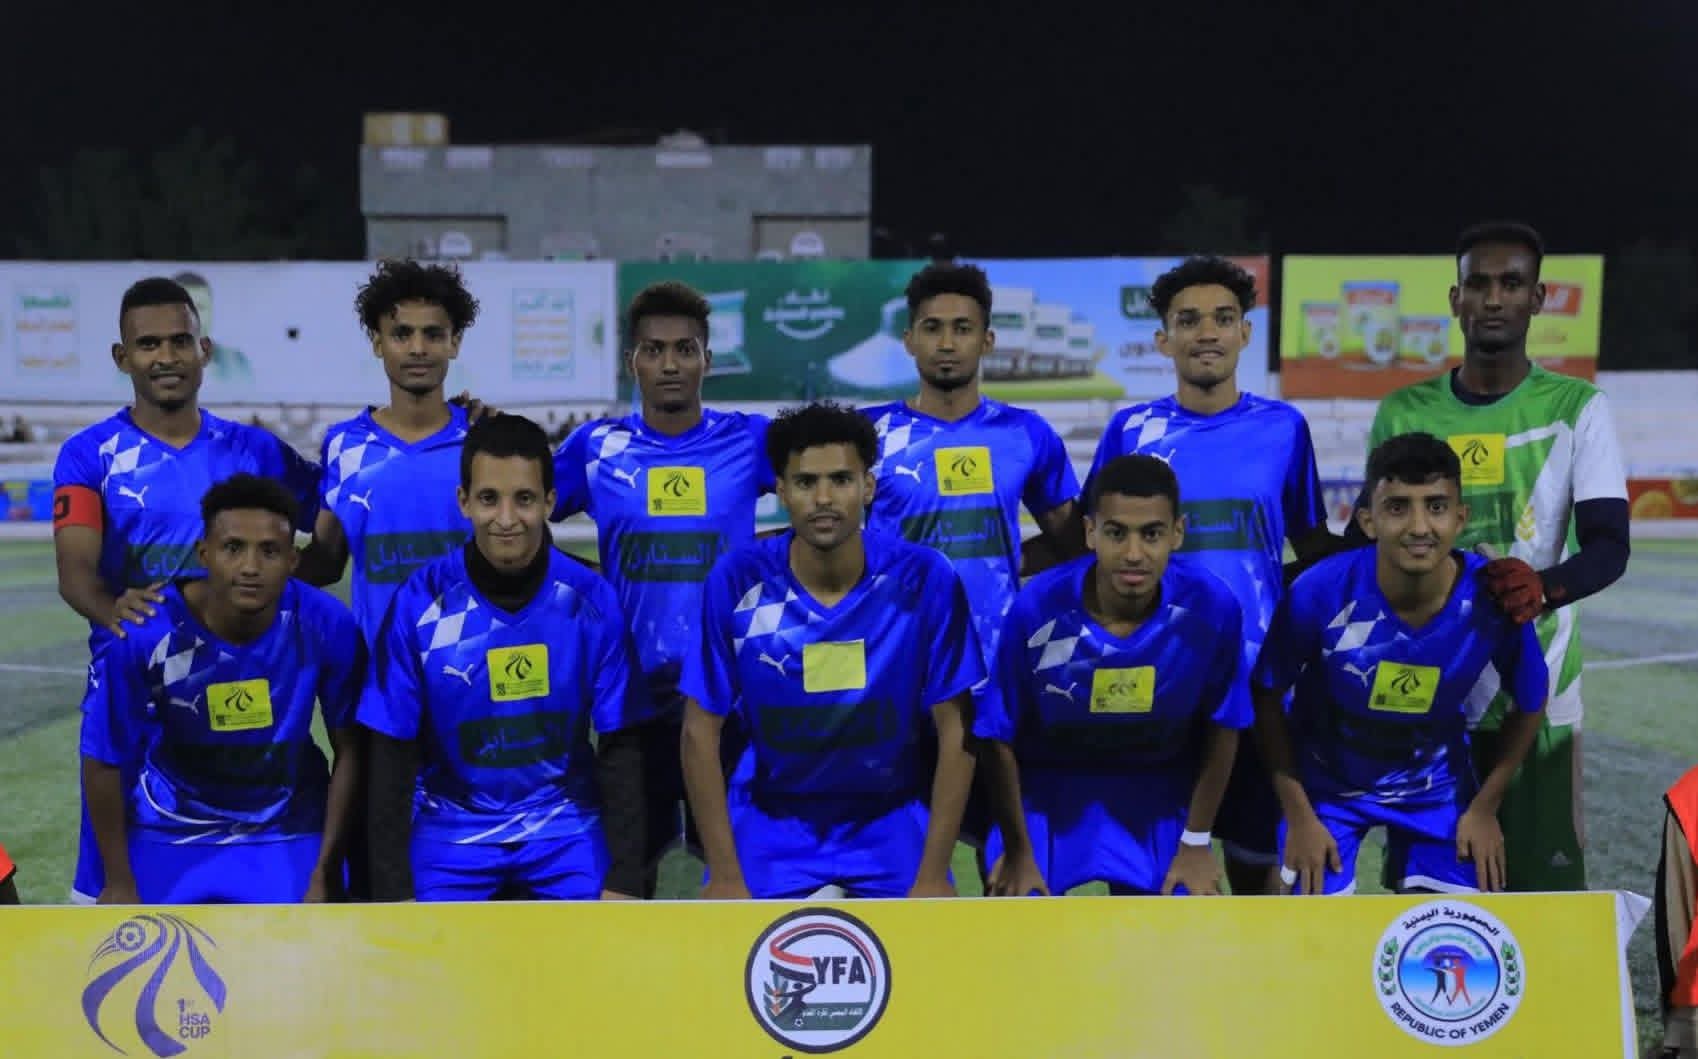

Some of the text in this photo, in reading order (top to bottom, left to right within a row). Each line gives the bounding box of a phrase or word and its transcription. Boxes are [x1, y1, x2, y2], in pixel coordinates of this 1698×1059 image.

[1402, 906, 1500, 937] الجمهورية اليمنية
[813, 955, 866, 985] YFA
[180, 1012, 211, 1025] HSA
[180, 1026, 211, 1039] CUP
[1390, 1001, 1446, 1039] REPUBLIC
[1449, 1028, 1467, 1040] OF
[1470, 1002, 1510, 1036] YEMEN
